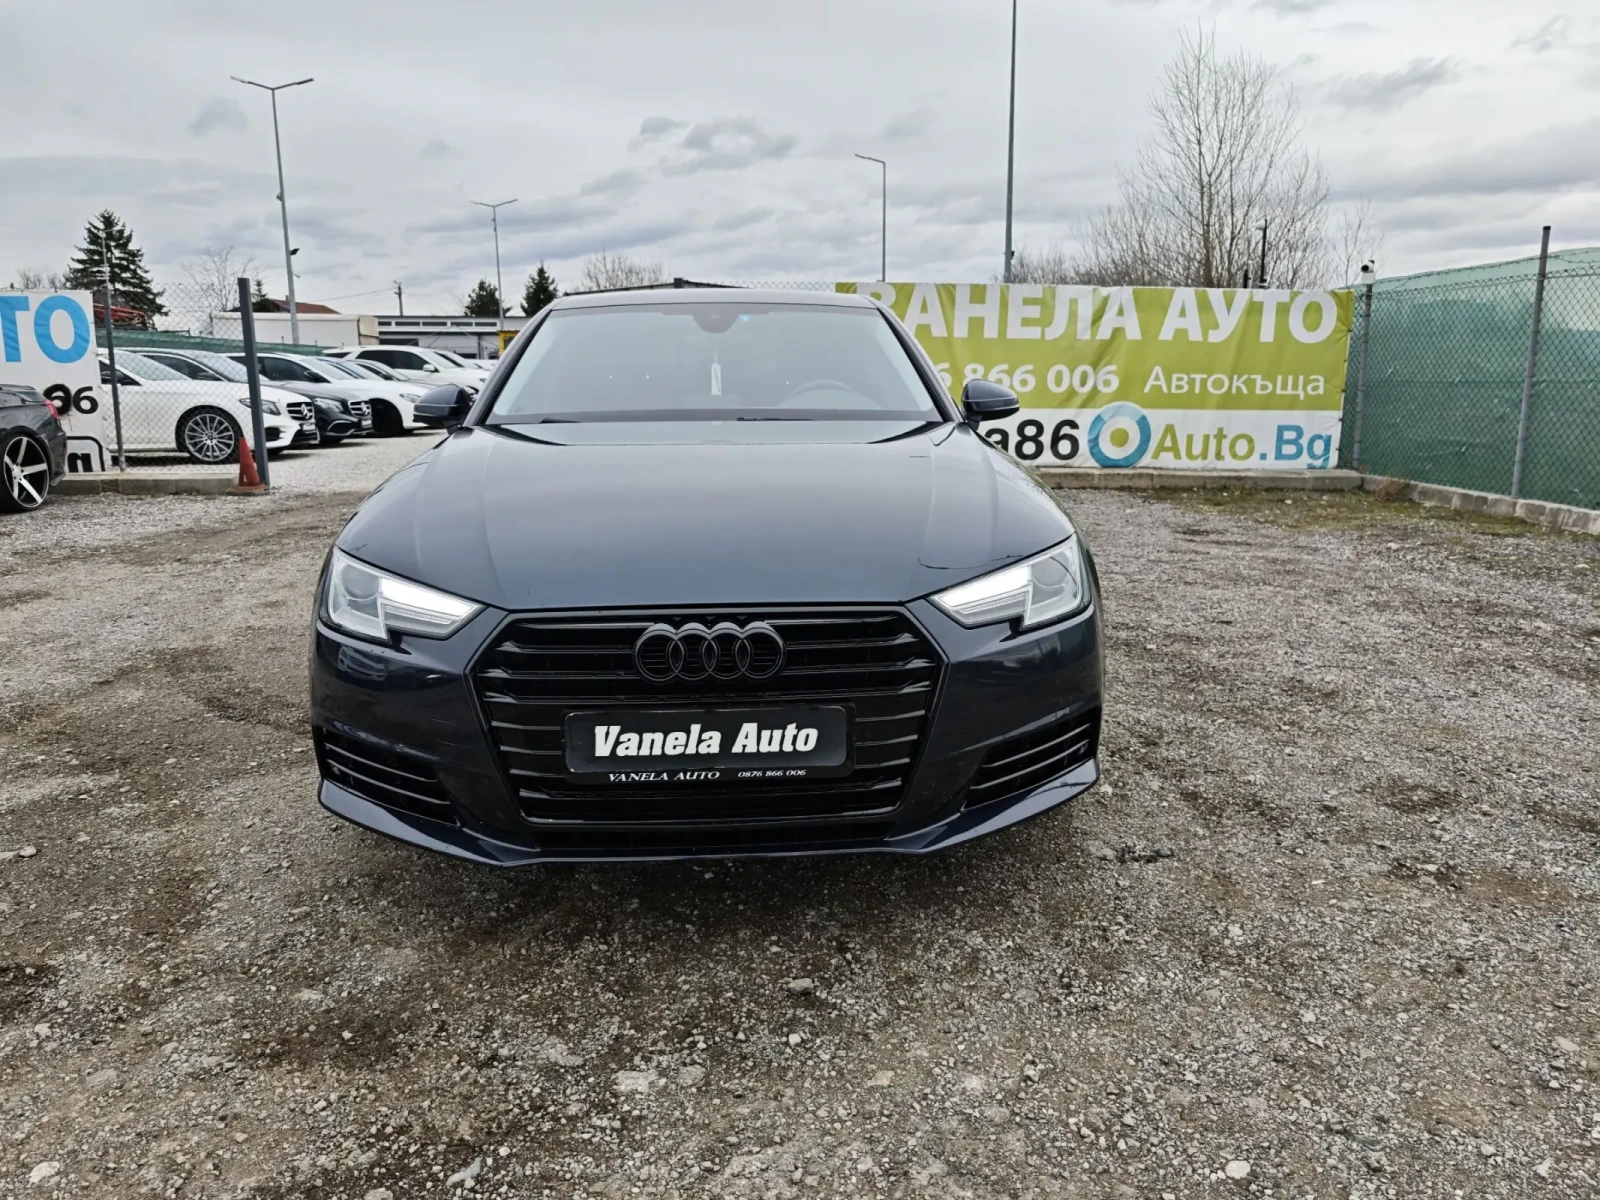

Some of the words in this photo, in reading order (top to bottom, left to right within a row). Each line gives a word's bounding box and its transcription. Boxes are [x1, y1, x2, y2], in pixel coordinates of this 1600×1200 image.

[1157, 287, 1338, 344] АУТО
[1047, 364, 1120, 394] 006
[1143, 365, 1325, 400] Автокъща
[594, 723, 722, 757] Vanela
[731, 722, 819, 754] Auto
[608, 772, 669, 783] VANELA
[673, 771, 720, 781] AUTO
[738, 770, 763, 778] 0876
[786, 769, 807, 777] 006
